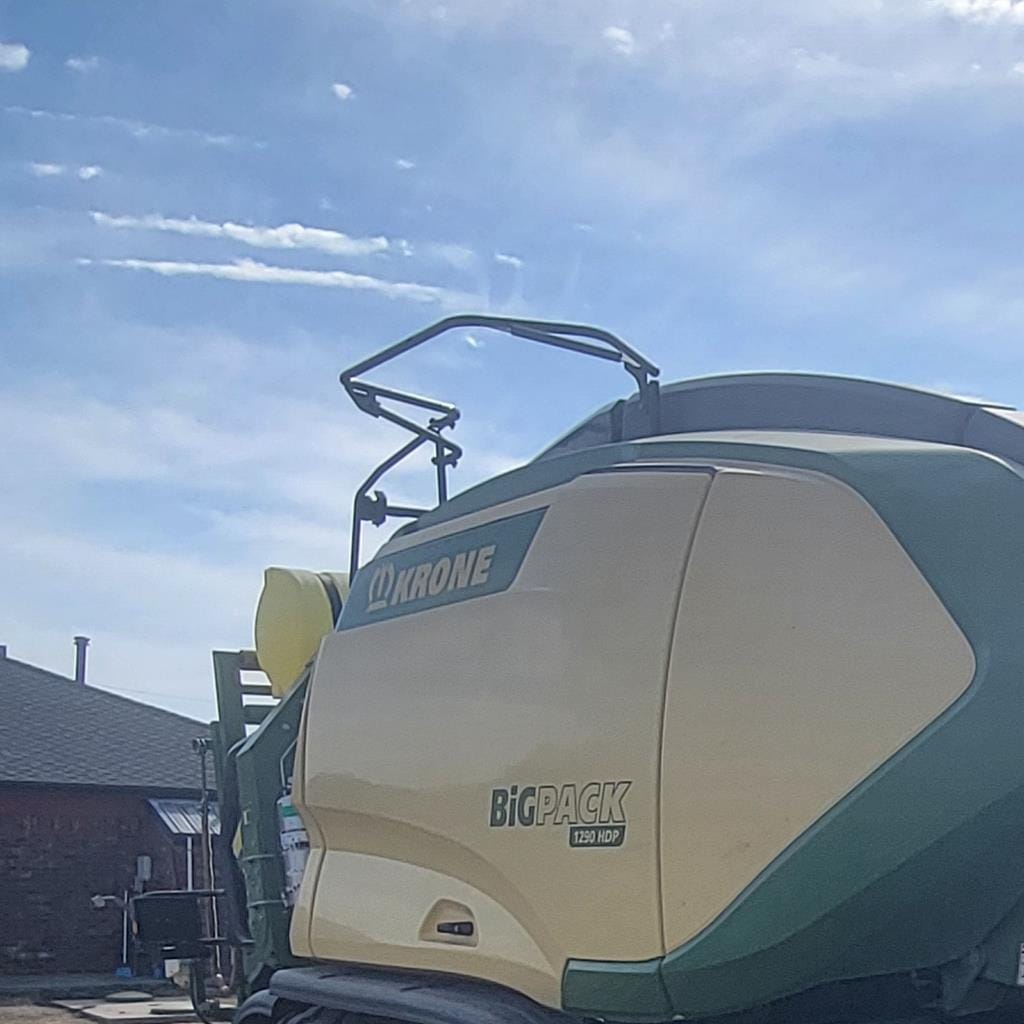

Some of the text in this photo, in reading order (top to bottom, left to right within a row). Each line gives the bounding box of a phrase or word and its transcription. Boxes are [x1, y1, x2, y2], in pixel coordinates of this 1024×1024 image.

[391, 545, 496, 605] KRONE
[573, 829, 620, 844] 1290 HDP
